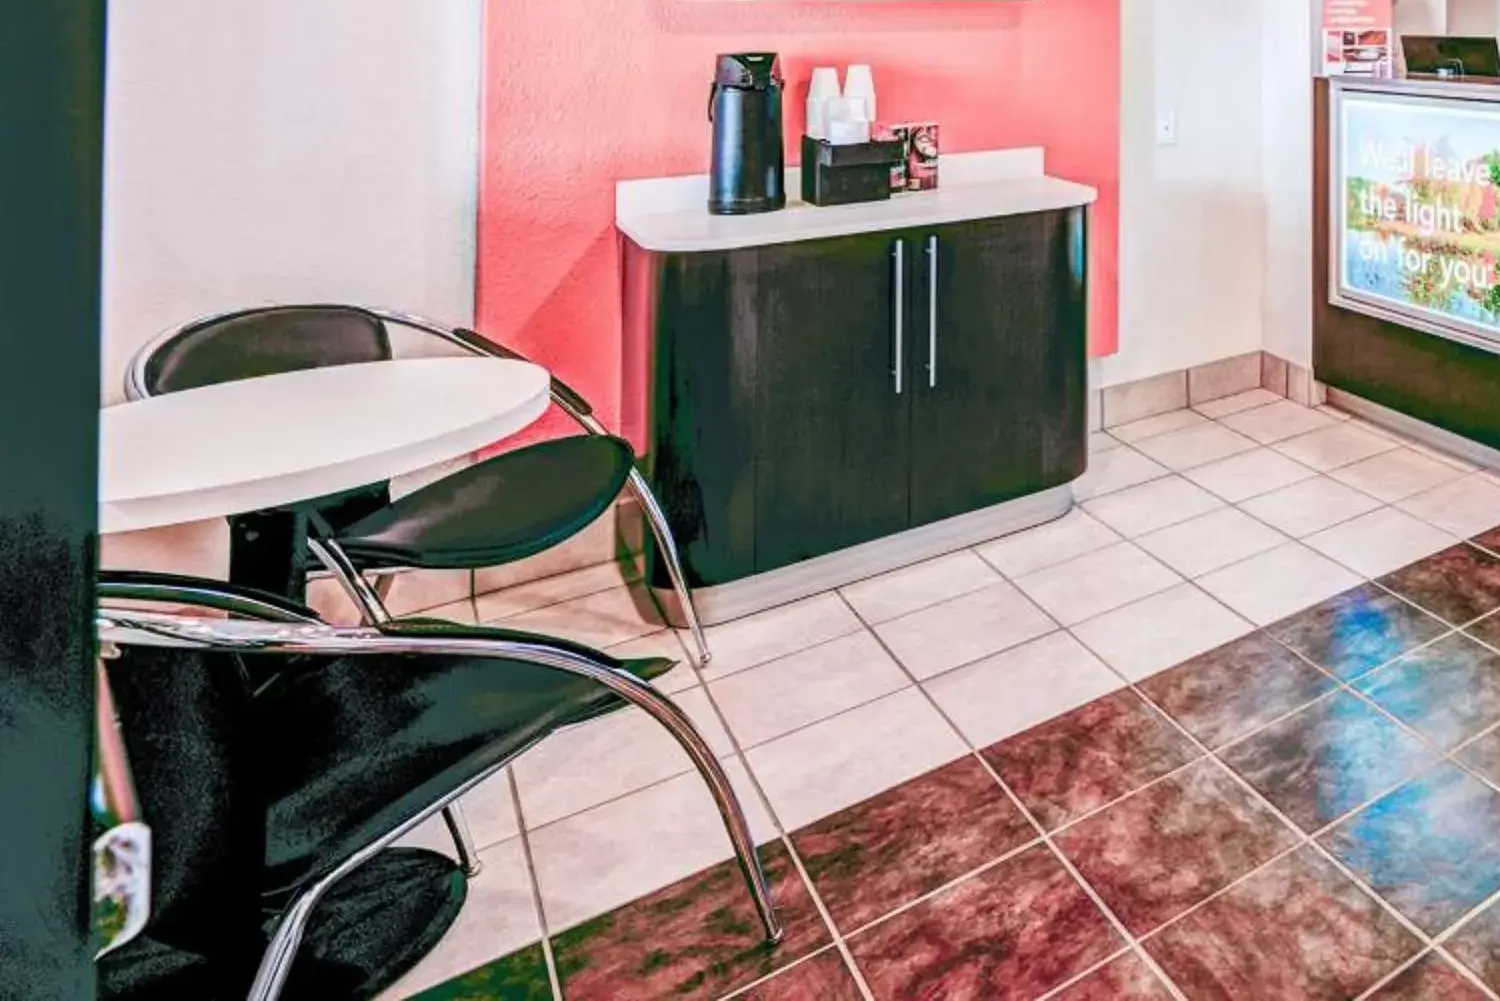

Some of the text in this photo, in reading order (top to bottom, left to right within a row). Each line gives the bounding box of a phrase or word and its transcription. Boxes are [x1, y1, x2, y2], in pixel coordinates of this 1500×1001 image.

[1424, 144, 1490, 186] leave
[1360, 186, 1464, 236] the light
[1360, 238, 1387, 264] on
[1393, 236, 1433, 273] for
